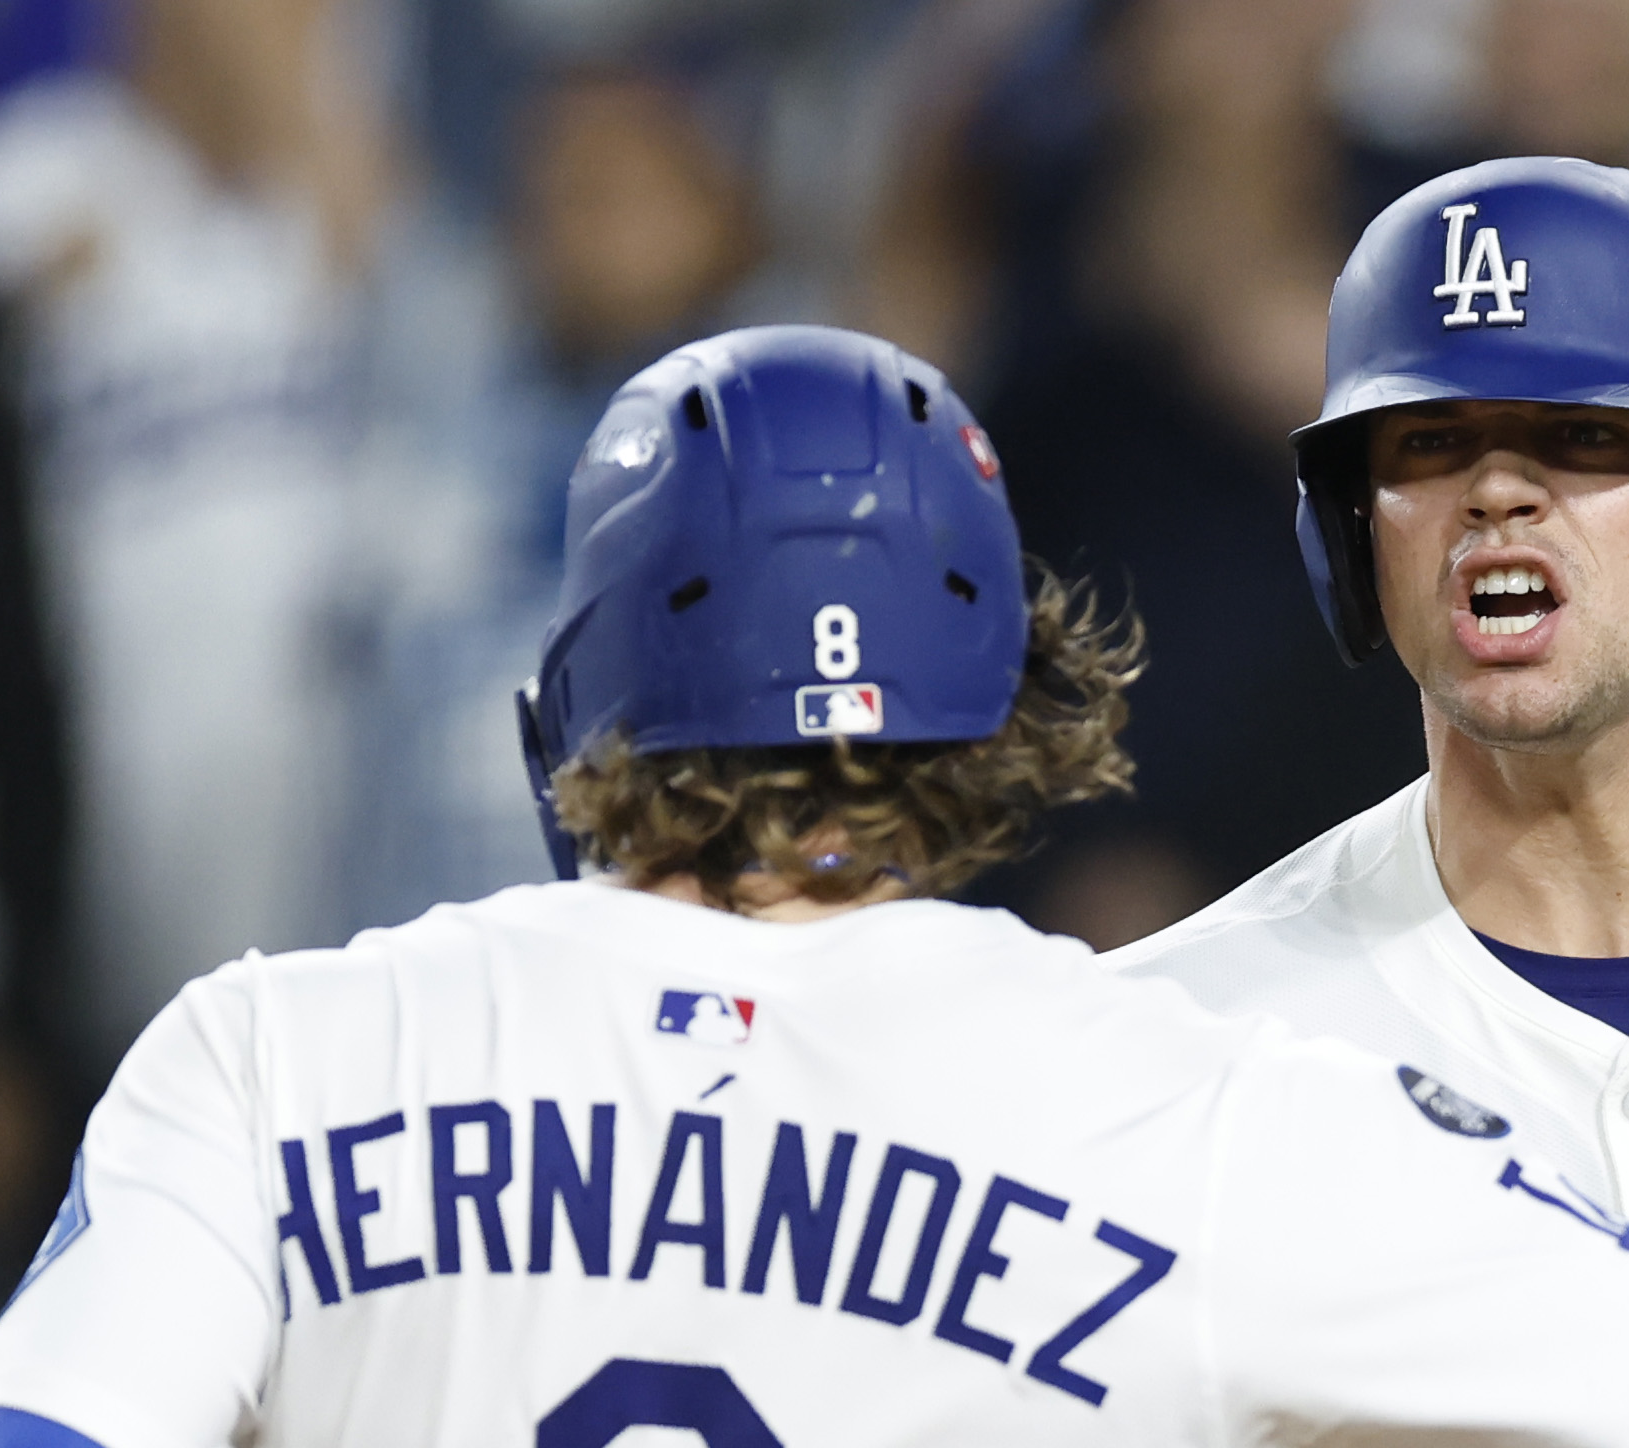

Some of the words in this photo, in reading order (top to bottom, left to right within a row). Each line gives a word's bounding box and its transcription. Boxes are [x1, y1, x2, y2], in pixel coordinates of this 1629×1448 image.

[1433, 203, 1528, 327] LA
[813, 603, 861, 681] 8
[277, 1072, 1177, 1408] HERNÁNDEZ
